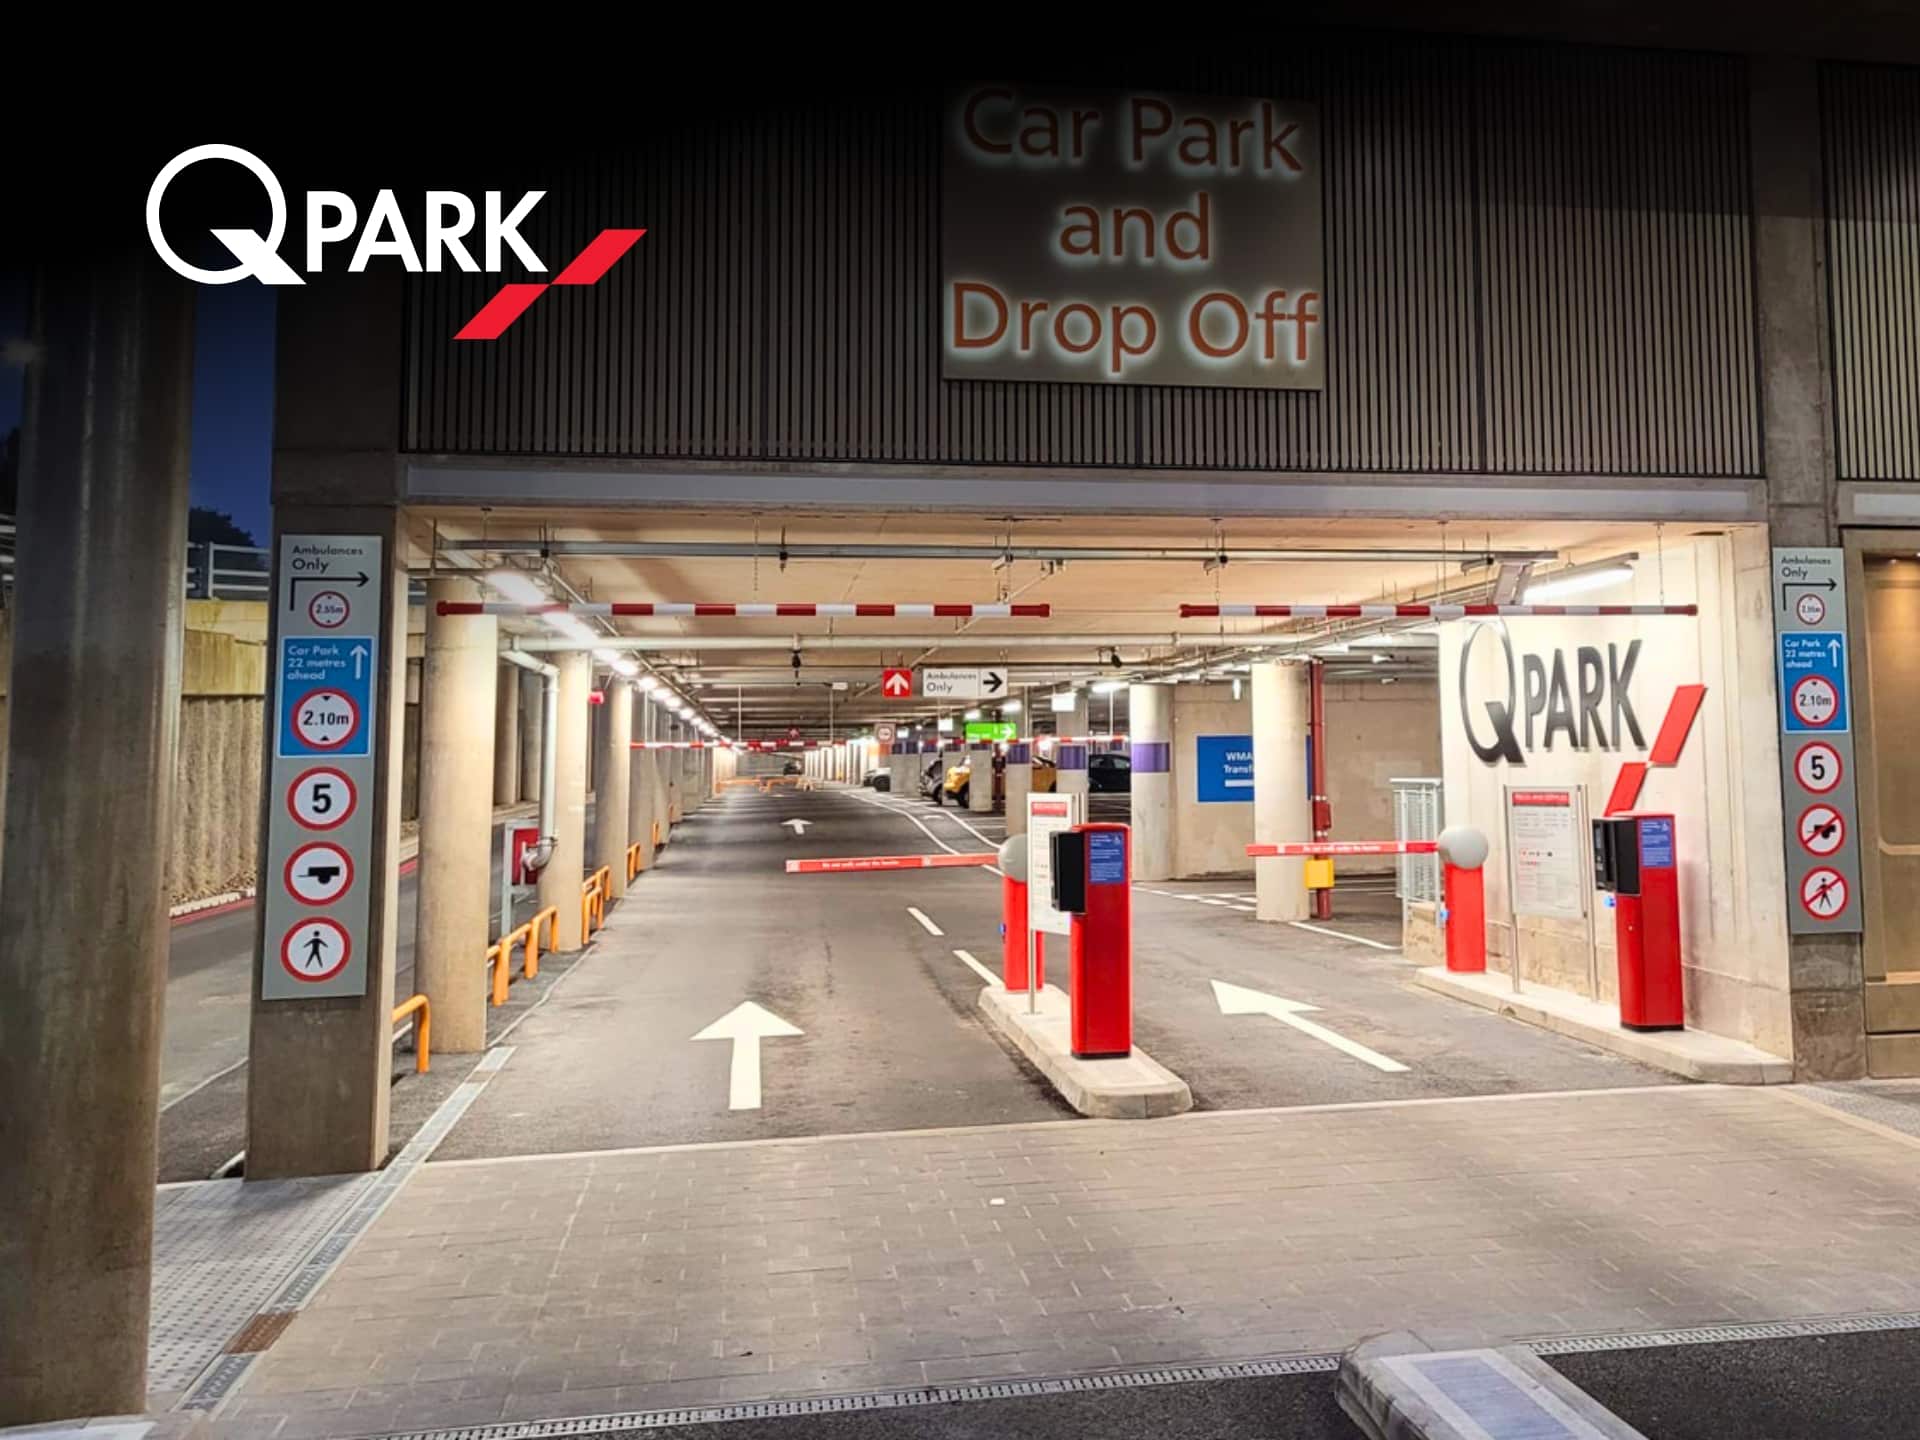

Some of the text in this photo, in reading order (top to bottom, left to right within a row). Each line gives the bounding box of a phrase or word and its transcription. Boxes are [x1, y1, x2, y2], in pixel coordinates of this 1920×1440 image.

[963, 87, 1304, 172] Car Park
[1059, 191, 1211, 261] and
[952, 281, 1320, 374] Drop Off
[291, 544, 364, 556] Ambulances
[291, 557, 329, 574] Only
[1781, 554, 1831, 565] Ambulances
[1781, 566, 1808, 580] Only
[1785, 638, 1820, 648] Car Park
[287, 643, 339, 657] Car Park
[1798, 650, 1826, 659] metres
[287, 657, 346, 668] 22 metres
[1785, 659, 1813, 668] ahead
[287, 669, 326, 680] ahead
[926, 671, 977, 680] Ambulances
[926, 681, 953, 694] Only
[1799, 693, 1832, 707] 2.10m
[302, 709, 350, 726] 2.10m
[1225, 751, 1253, 762] WMA
[1223, 763, 1252, 774] Transf
[1810, 755, 1826, 781] 5
[311, 783, 333, 814] 5
